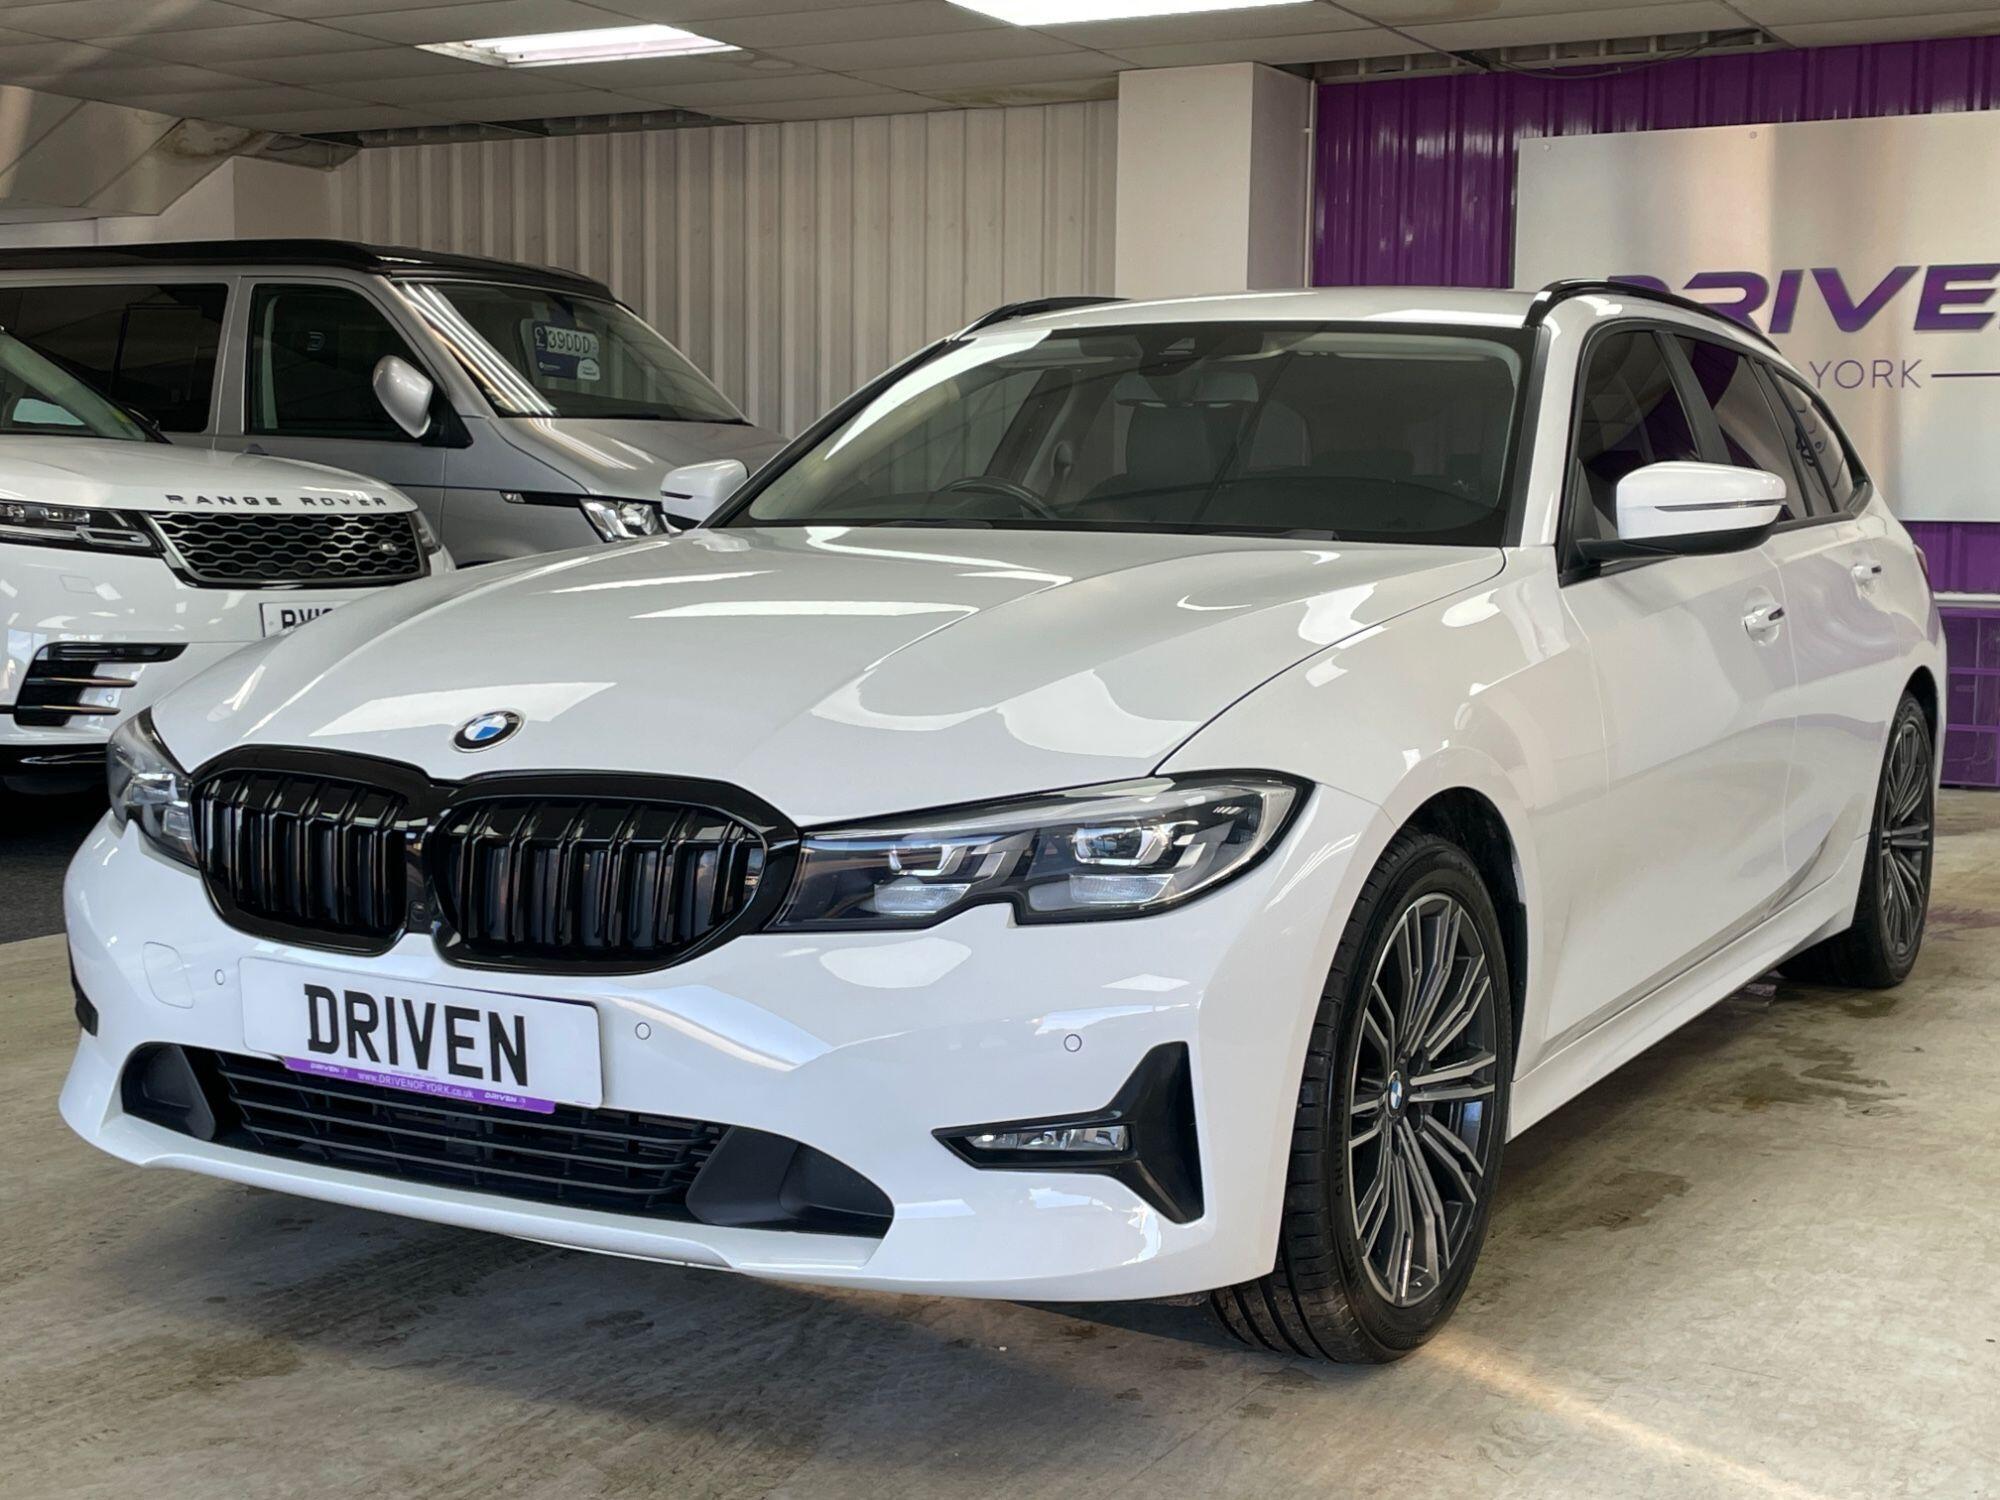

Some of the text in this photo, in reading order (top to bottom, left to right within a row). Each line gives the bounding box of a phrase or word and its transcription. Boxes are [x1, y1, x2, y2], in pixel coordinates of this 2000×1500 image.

[1607, 264, 2000, 334] RIVE
[1809, 359, 1922, 389] YORK
[165, 494, 387, 506] RANGE ROVER
[304, 983, 528, 1087] DRIVEN
[484, 1091, 517, 1103] DRIVEN
